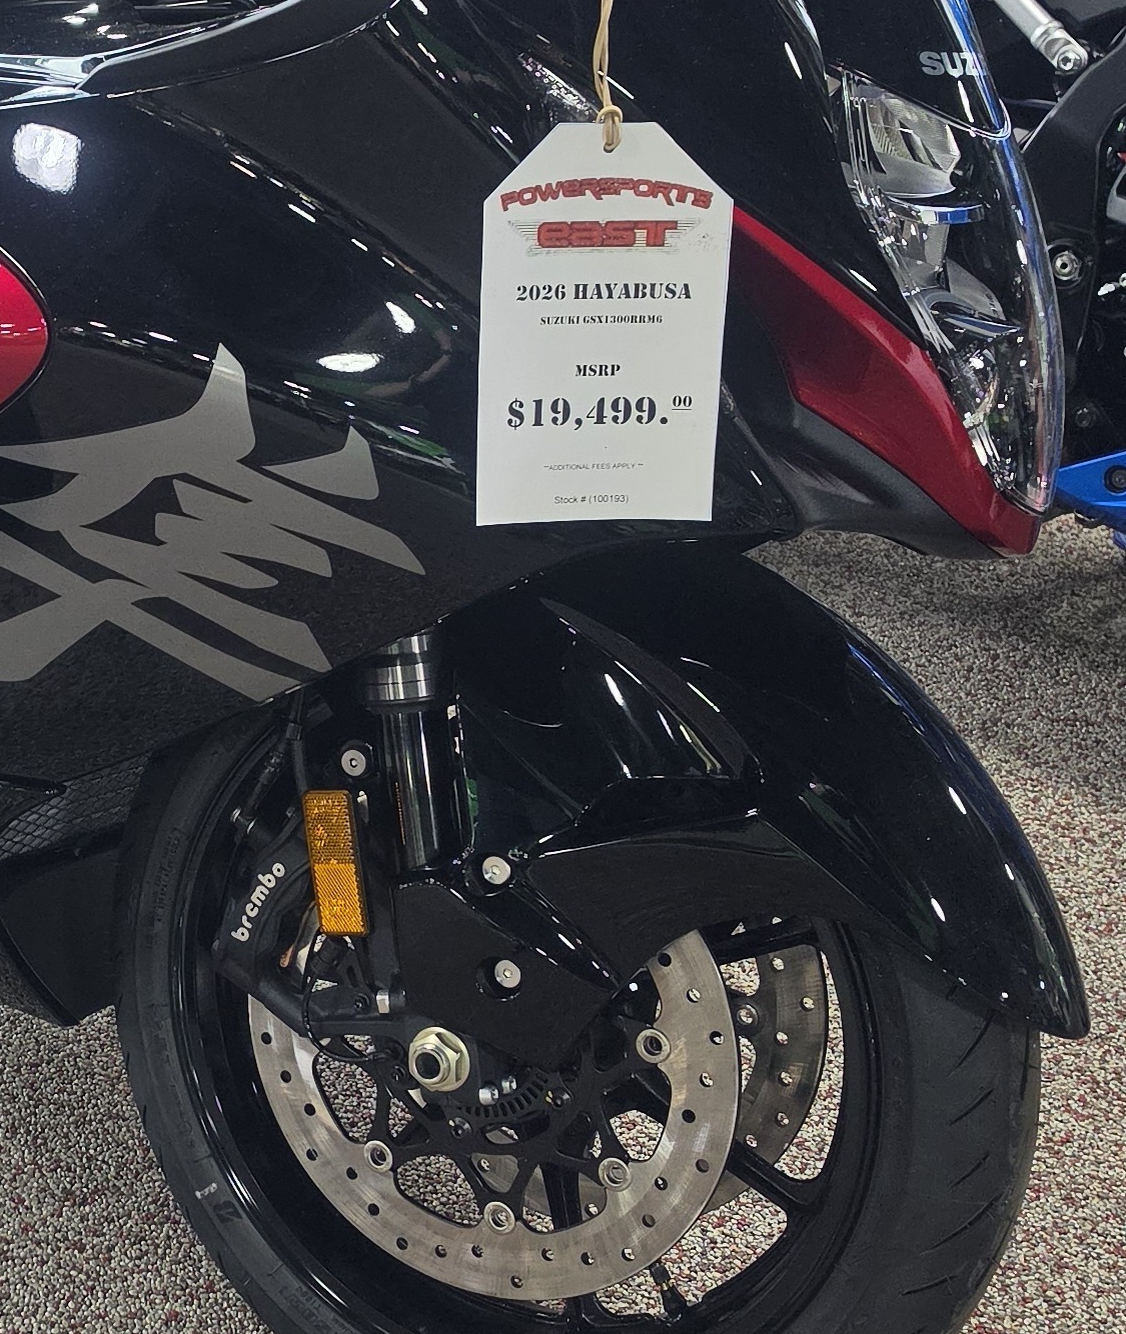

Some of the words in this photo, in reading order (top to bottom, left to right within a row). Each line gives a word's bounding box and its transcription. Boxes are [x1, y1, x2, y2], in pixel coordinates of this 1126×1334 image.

[499, 177, 714, 212] POWERSPORTS
[516, 283, 566, 302] 2026
[573, 281, 692, 301] HAYABUSA
[539, 315, 581, 326] SUZUKI
[582, 314, 663, 326] GSX1300RRM6
[575, 363, 621, 378] MSRP
[591, 462, 611, 471] FEES
[554, 495, 579, 505] Stock
[580, 495, 587, 503] #
[588, 494, 629, 505] (100193)
[231, 862, 285, 942] brembo
